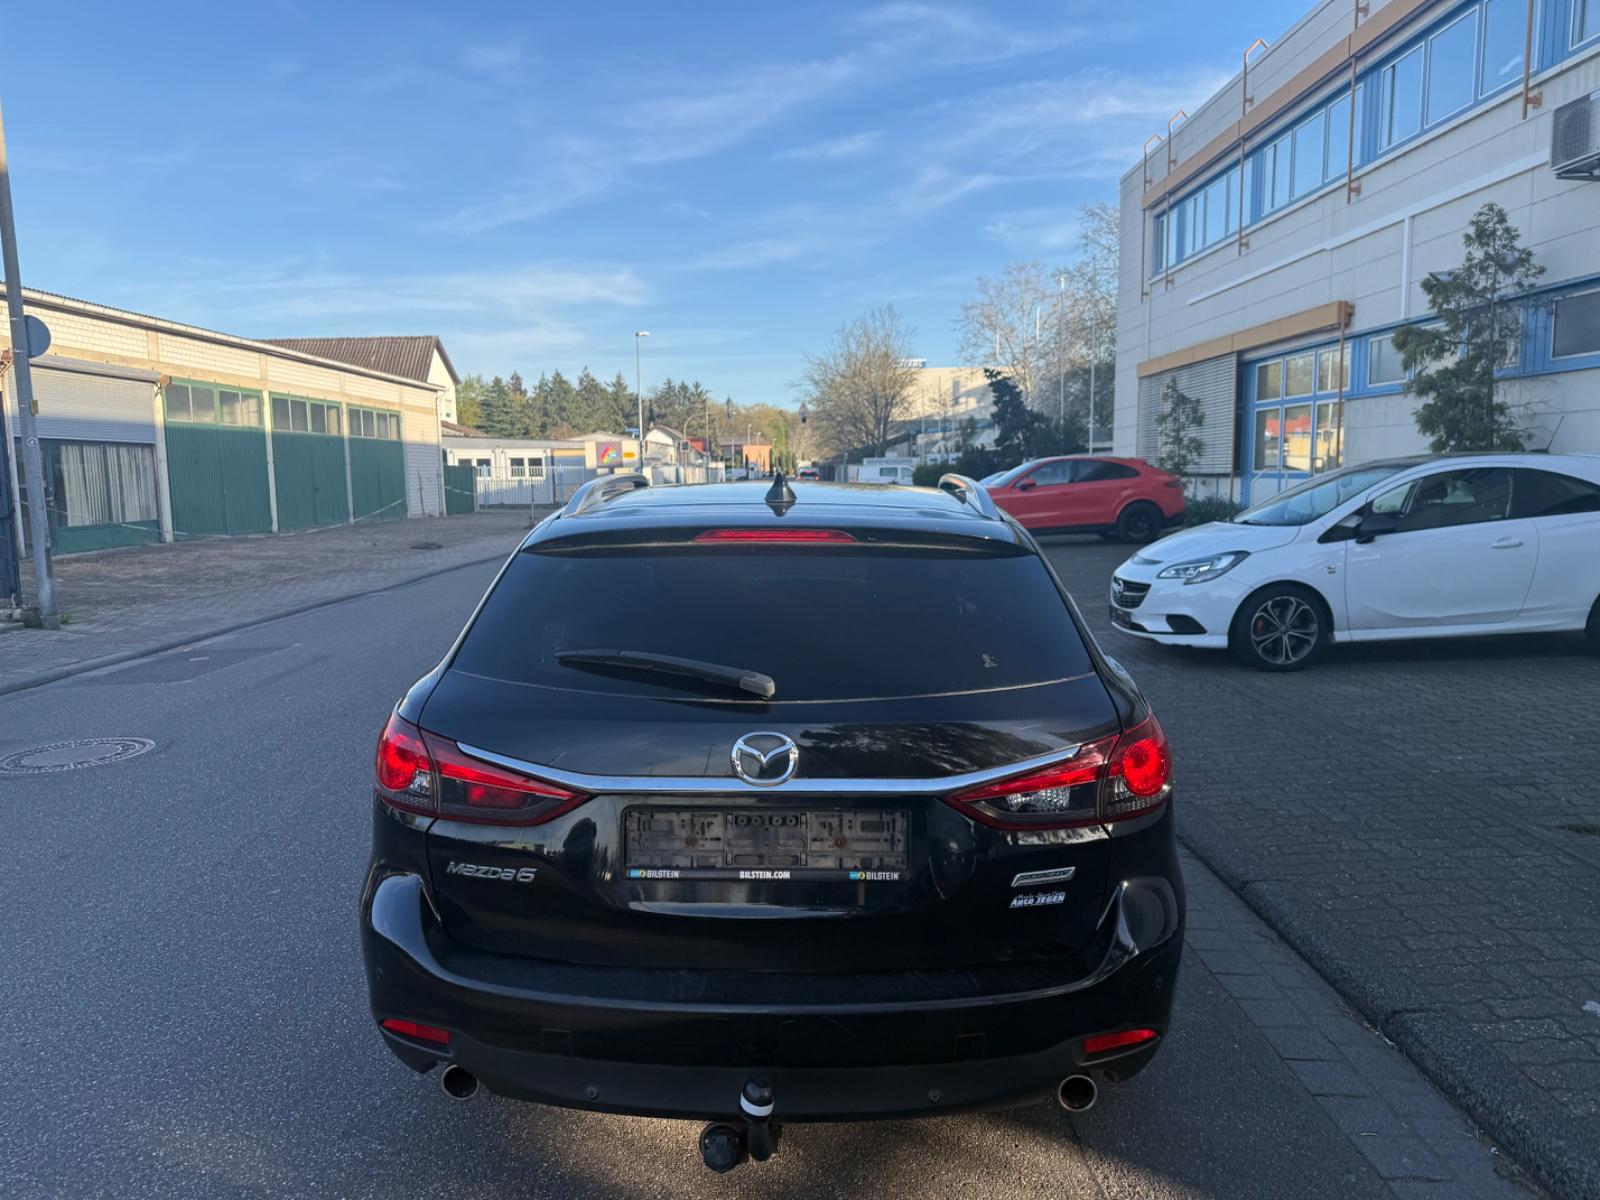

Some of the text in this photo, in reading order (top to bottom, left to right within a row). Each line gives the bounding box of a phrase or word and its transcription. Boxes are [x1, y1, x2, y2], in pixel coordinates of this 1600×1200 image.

[646, 870, 680, 879] BILSTEIN
[739, 870, 791, 880] BILSTEIN.COM
[866, 871, 900, 881] BILSTEIN
